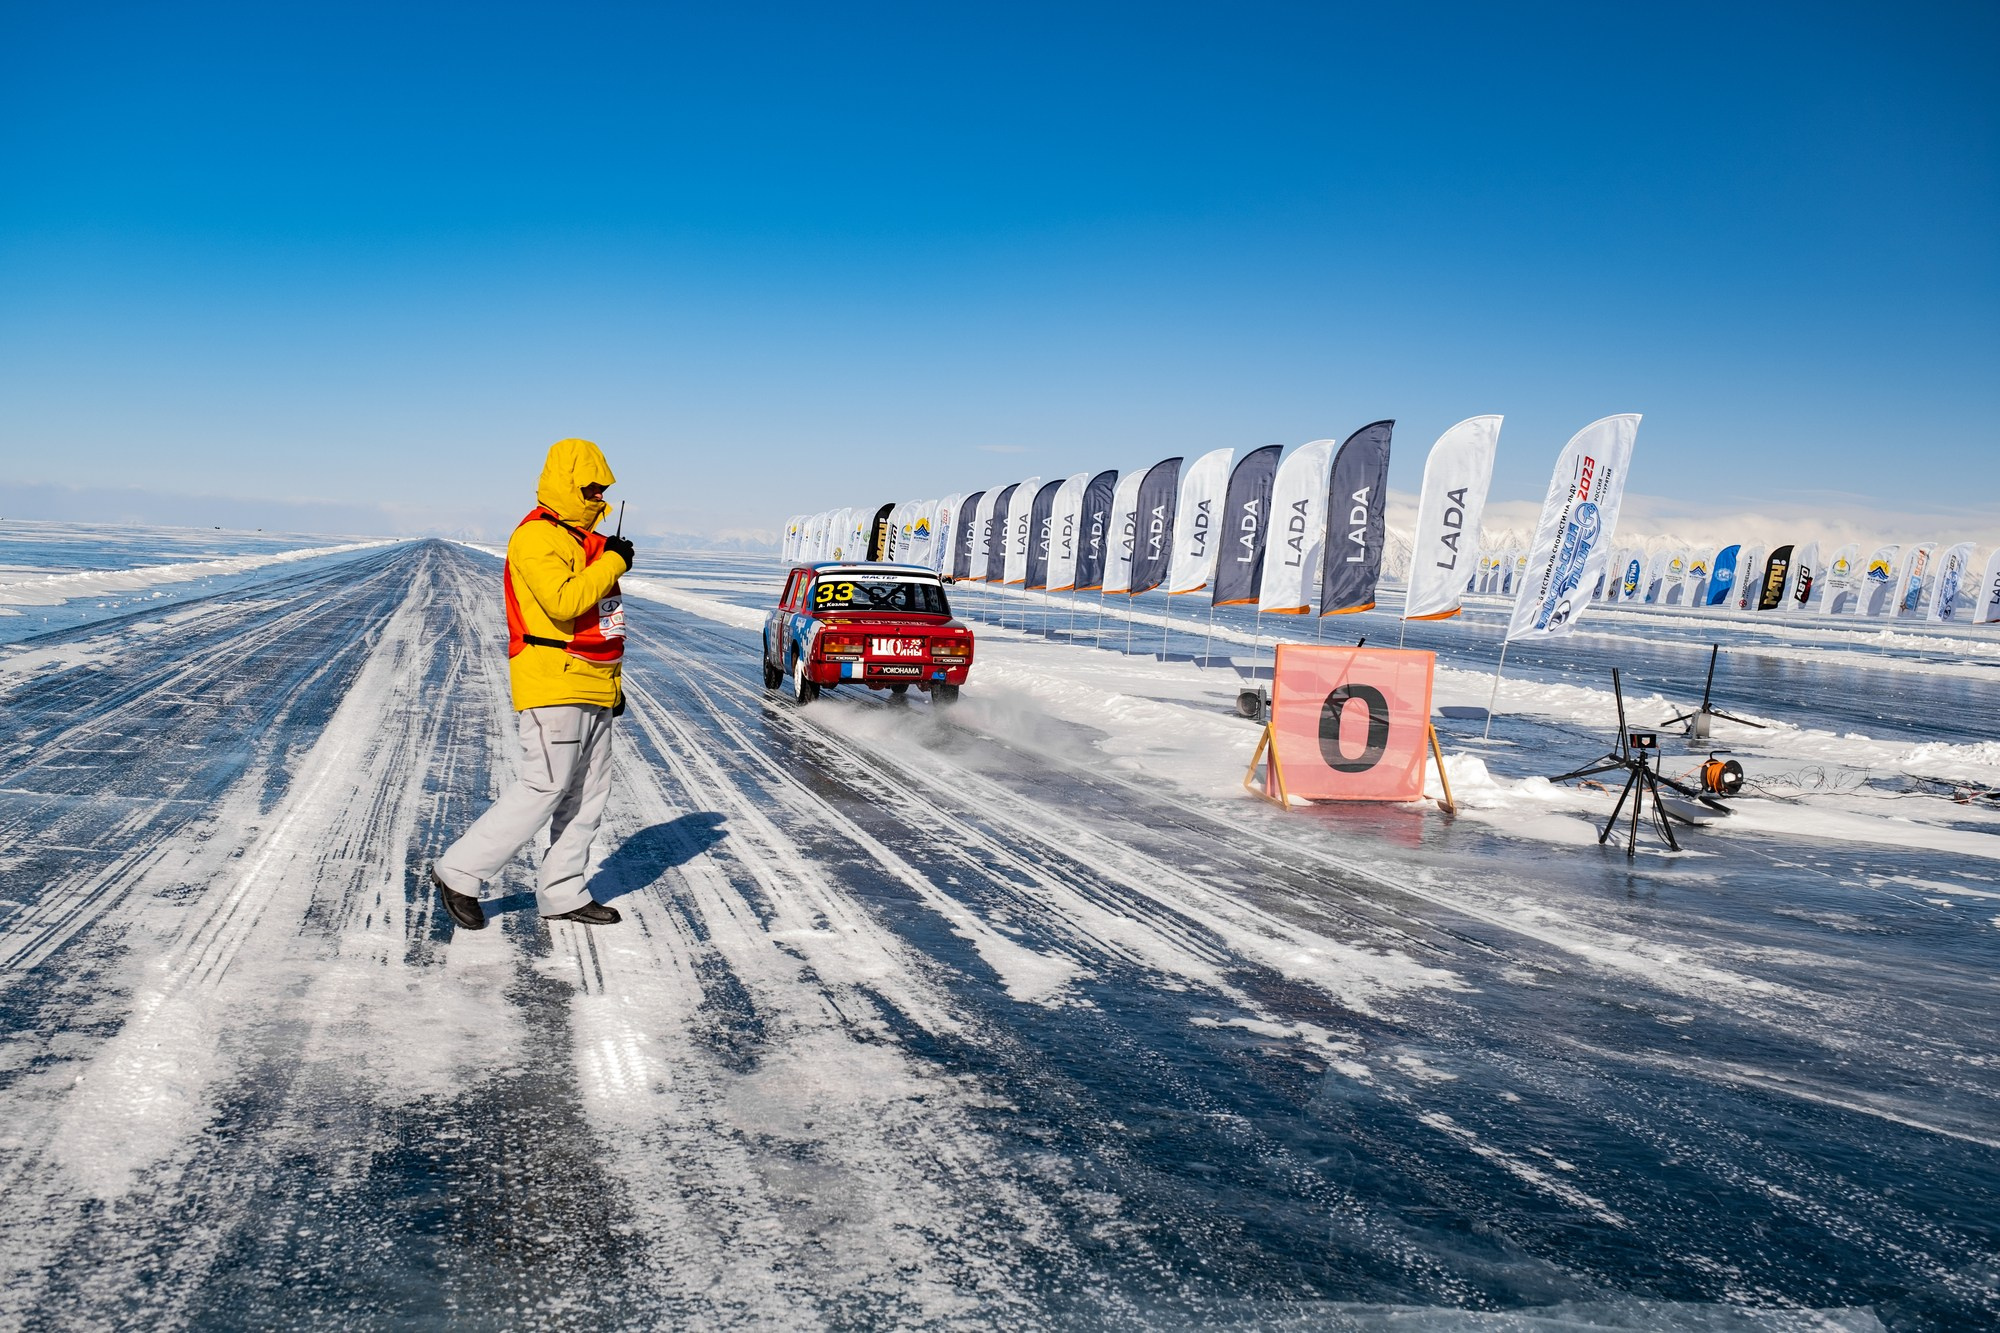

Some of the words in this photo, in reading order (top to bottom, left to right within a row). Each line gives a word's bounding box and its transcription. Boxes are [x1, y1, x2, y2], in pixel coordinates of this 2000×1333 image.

[1567, 484, 1577, 504] ЛЬДУ
[1576, 455, 1595, 502] 2023
[1593, 478, 1603, 502] РОССИЯ
[1602, 468, 1612, 494] БУРЯТИЯ
[1190, 499, 1212, 557] LADA
[1237, 499, 1259, 563] LADA
[1346, 486, 1370, 563] LADA
[1436, 487, 1468, 571] LADA
[1564, 504, 1571, 515] НА
[1016, 513, 1029, 555] LADA
[1038, 516, 1052, 561] LADA
[1061, 513, 1075, 560] LADA
[1088, 510, 1104, 560] LADA
[1120, 511, 1137, 562] LADA
[1147, 505, 1165, 561] LADA
[1284, 499, 1309, 567] LADA
[1552, 515, 1567, 554] СКОРОСТИ
[816, 582, 855, 603] 33
[1540, 552, 1556, 596] ФЕСТИВАЛЬ
[1764, 559, 1786, 605] МАТЧ!
[1797, 567, 1809, 600] АВТО
[882, 667, 920, 675] YOKOHAMA
[1319, 683, 1389, 773] 0
